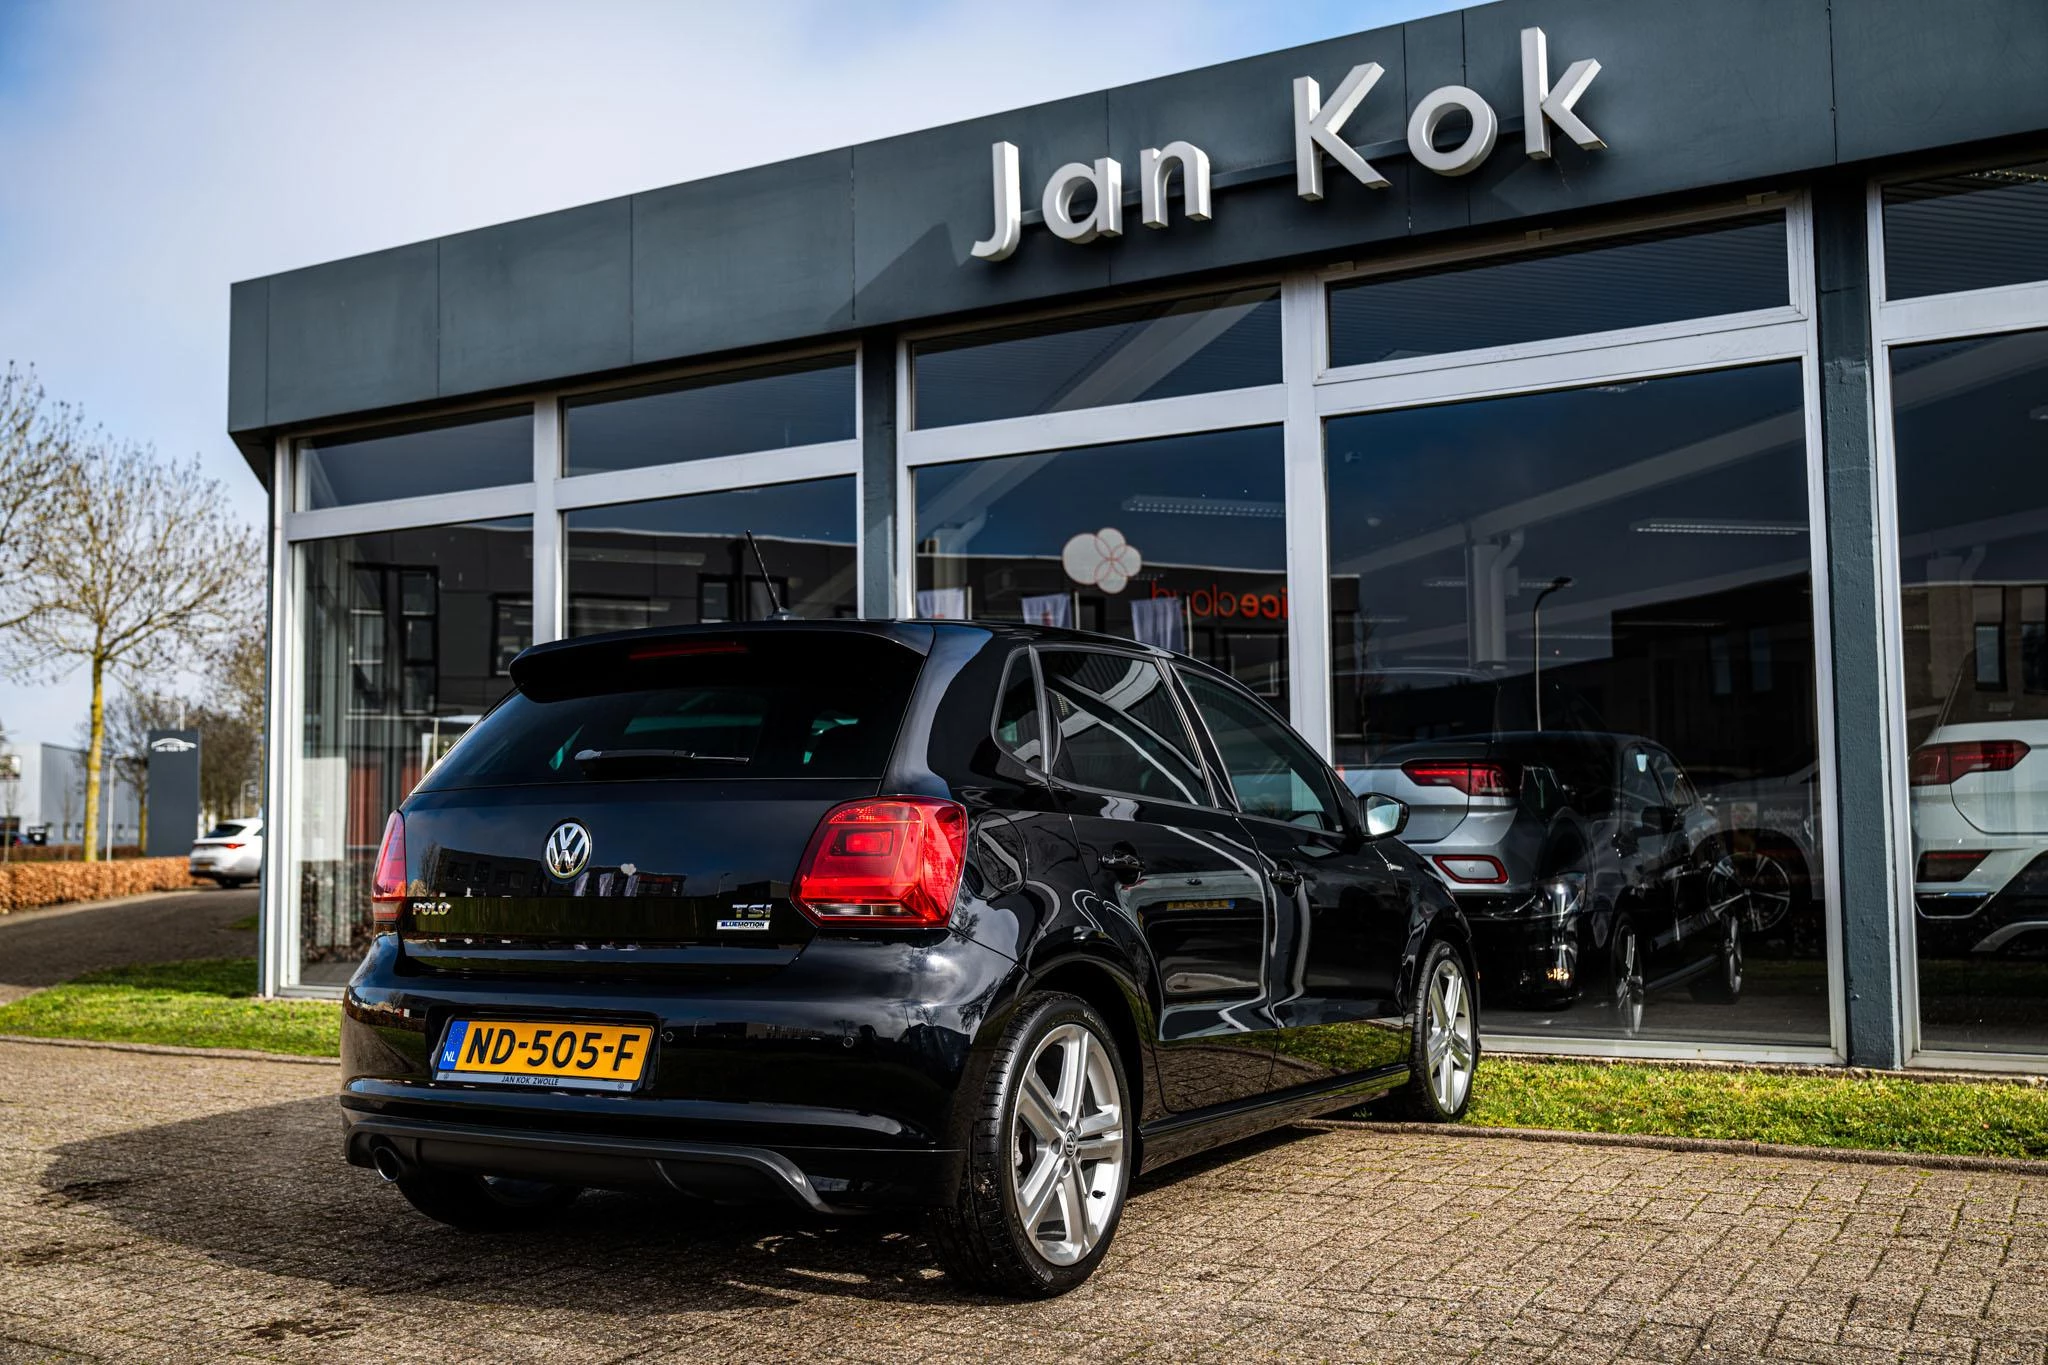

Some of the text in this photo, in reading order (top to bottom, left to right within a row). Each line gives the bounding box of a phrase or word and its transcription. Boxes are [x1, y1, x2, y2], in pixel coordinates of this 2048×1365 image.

[971, 27, 1607, 262] Jan Kok
[412, 902, 451, 915] POLO
[732, 904, 772, 918] TSI
[443, 1050, 456, 1062] NL
[465, 1027, 640, 1072] ND-505-F
[516, 1076, 531, 1084] KOK
[533, 1077, 559, 1085] ZWOLLE
